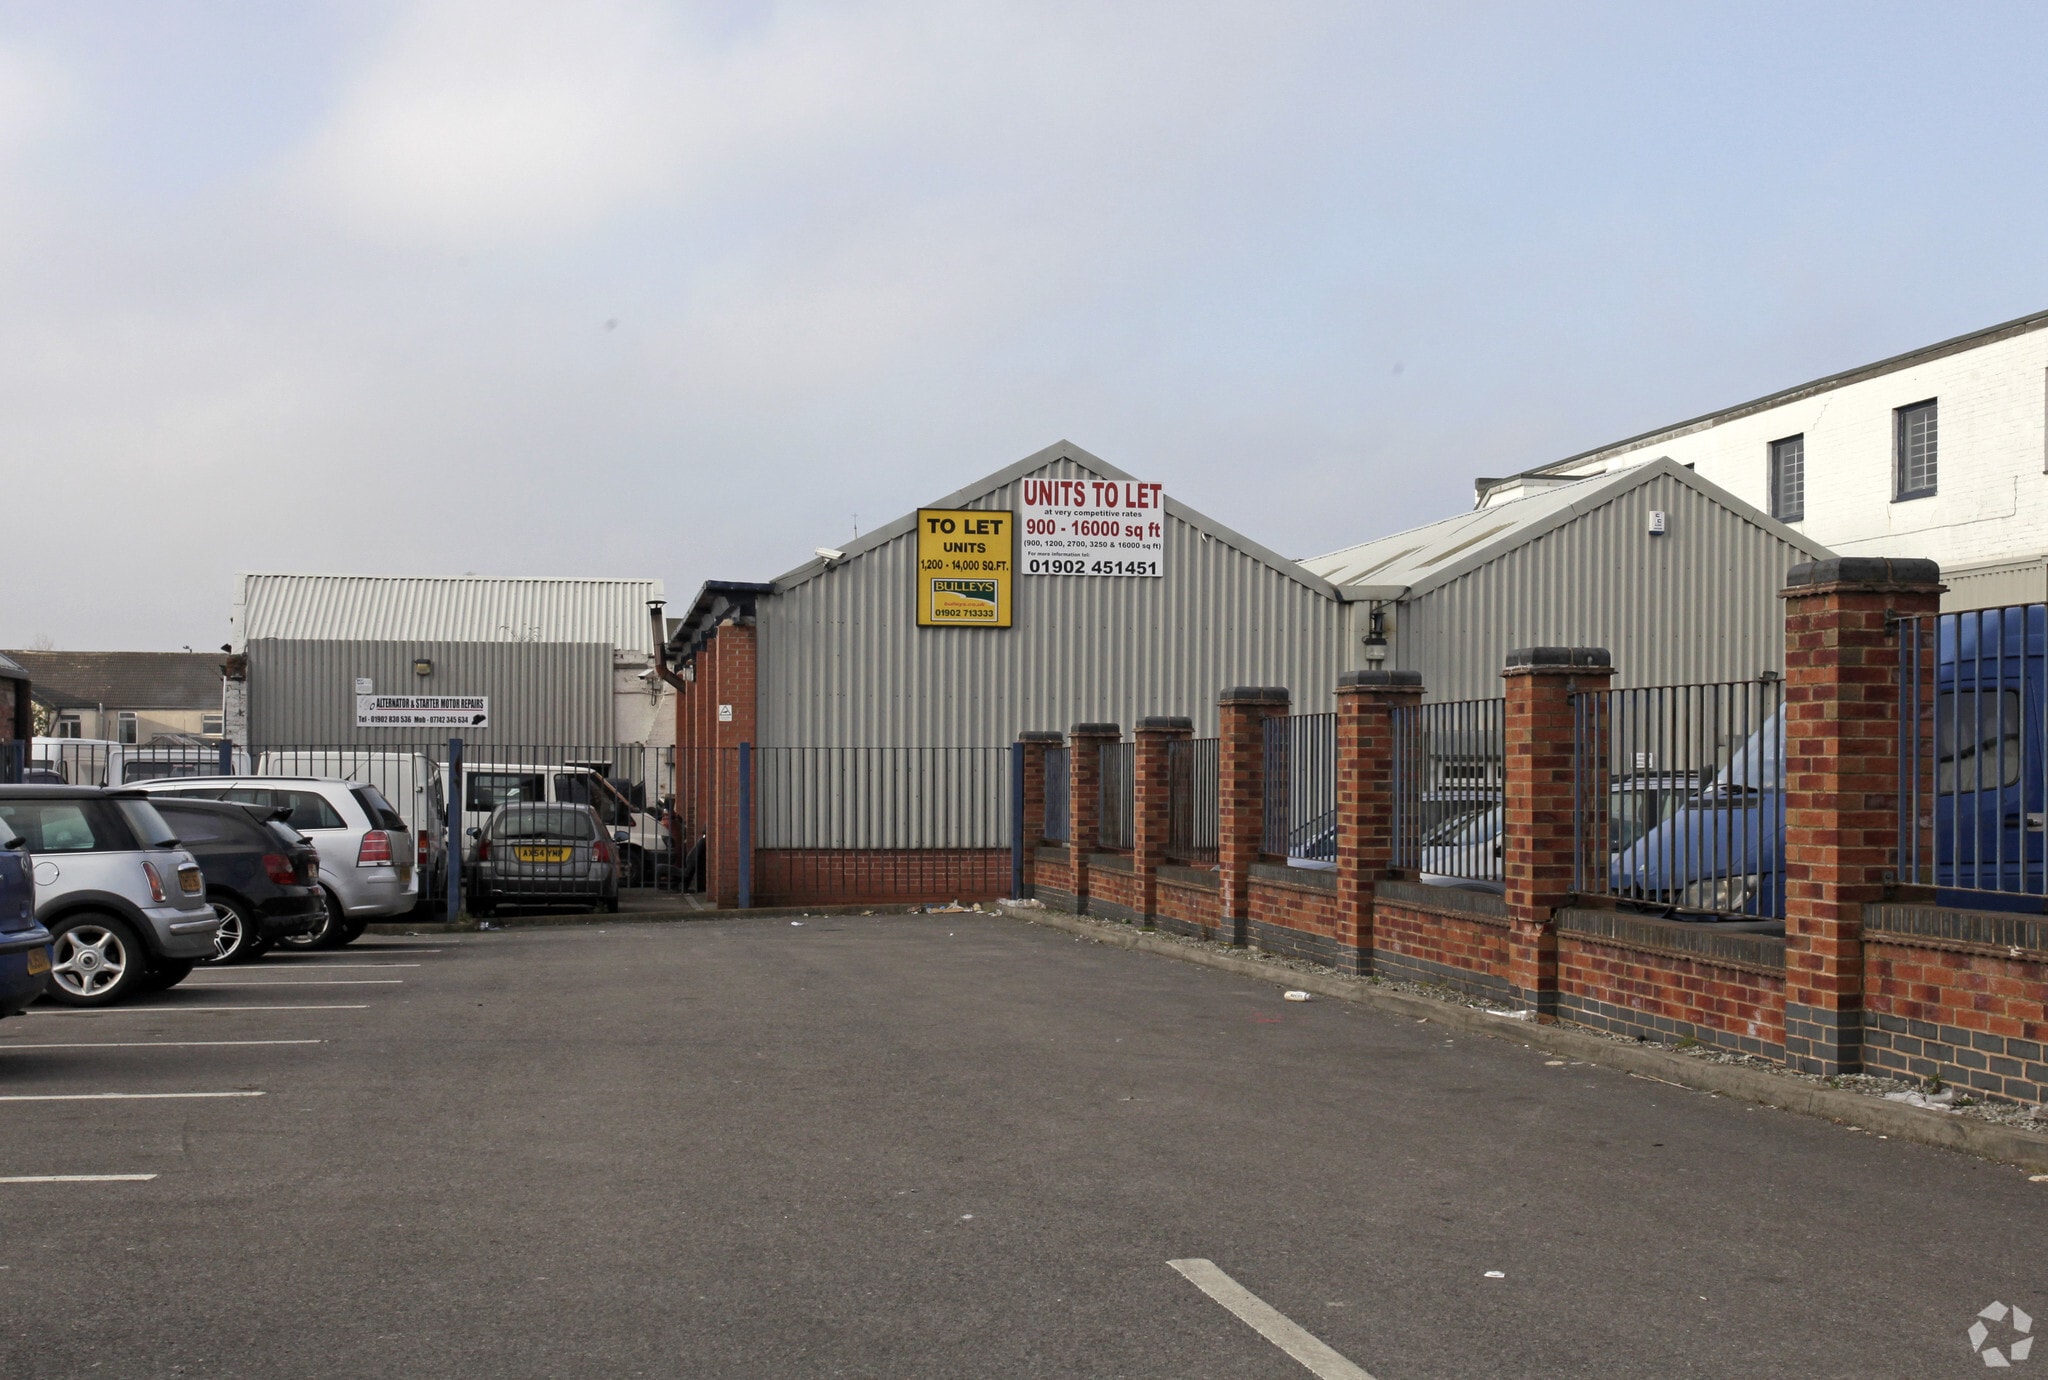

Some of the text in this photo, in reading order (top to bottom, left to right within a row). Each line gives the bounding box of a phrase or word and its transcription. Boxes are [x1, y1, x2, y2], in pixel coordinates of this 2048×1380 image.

[1024, 480, 1162, 509] UNITS TO LET
[927, 519, 1003, 535] TO LET
[1026, 519, 1056, 535] 900
[1071, 520, 1119, 537] 16000
[1125, 524, 1143, 541] sq
[1148, 522, 1160, 537] ft
[944, 543, 986, 553] UNITS
[1045, 540, 1065, 548] 1200,
[1152, 542, 1161, 550] ft)
[921, 560, 943, 571] 1,200
[952, 561, 979, 571] 14,000
[982, 561, 1009, 571] SQ.FT.
[1029, 559, 1156, 575] 01902 451451
[935, 581, 994, 592] BULLEYS
[935, 609, 961, 617] 01902
[376, 698, 483, 709] ALTERNATOR & STARTER MOTOR REPAIRS
